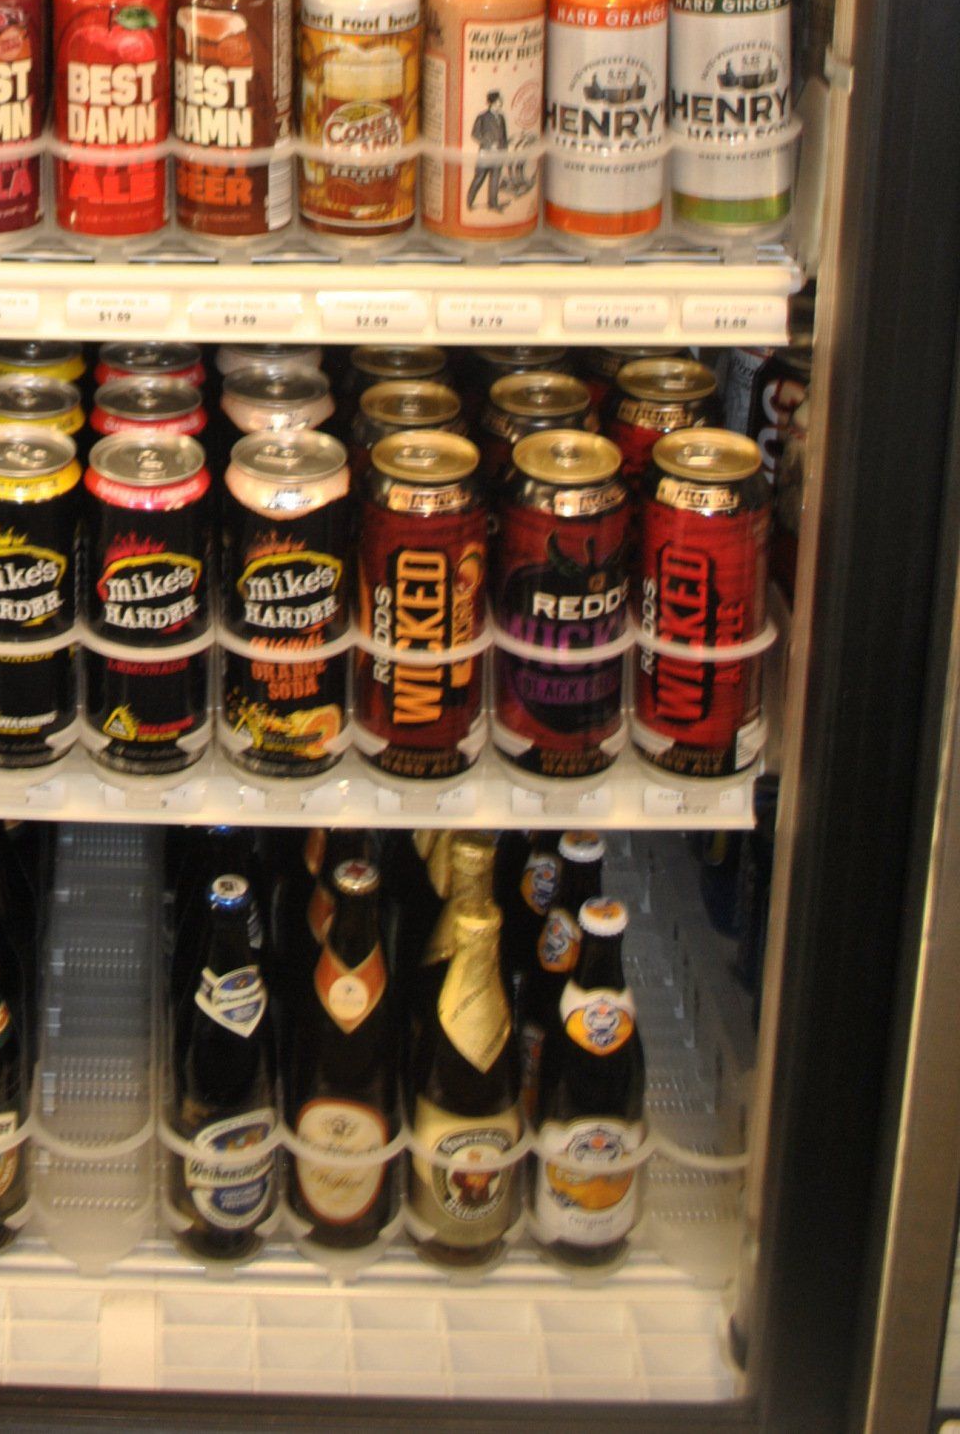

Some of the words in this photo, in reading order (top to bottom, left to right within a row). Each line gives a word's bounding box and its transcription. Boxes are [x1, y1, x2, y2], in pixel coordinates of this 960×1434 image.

[341, 17, 380, 30] root
[387, 13, 418, 29] beer
[558, 6, 597, 27] HARD
[605, 5, 667, 28] ORANGE
[469, 48, 512, 62] ROOT
[516, 44, 543, 60] BEE
[68, 61, 157, 107] BEST
[175, 58, 253, 108] BEST
[68, 102, 157, 145] DAMN
[175, 102, 253, 147] DAMN
[325, 115, 397, 141] CONEY
[69, 170, 157, 205] ALE
[177, 171, 253, 206] BEER
[106, 565, 196, 603] mike's
[246, 564, 336, 602] mike's
[104, 595, 198, 630] HARDER
[244, 595, 338, 630] HARDER
[393, 549, 448, 724] WICKED
[656, 546, 710, 720] WICKED
[268, 678, 320, 701] SODA
